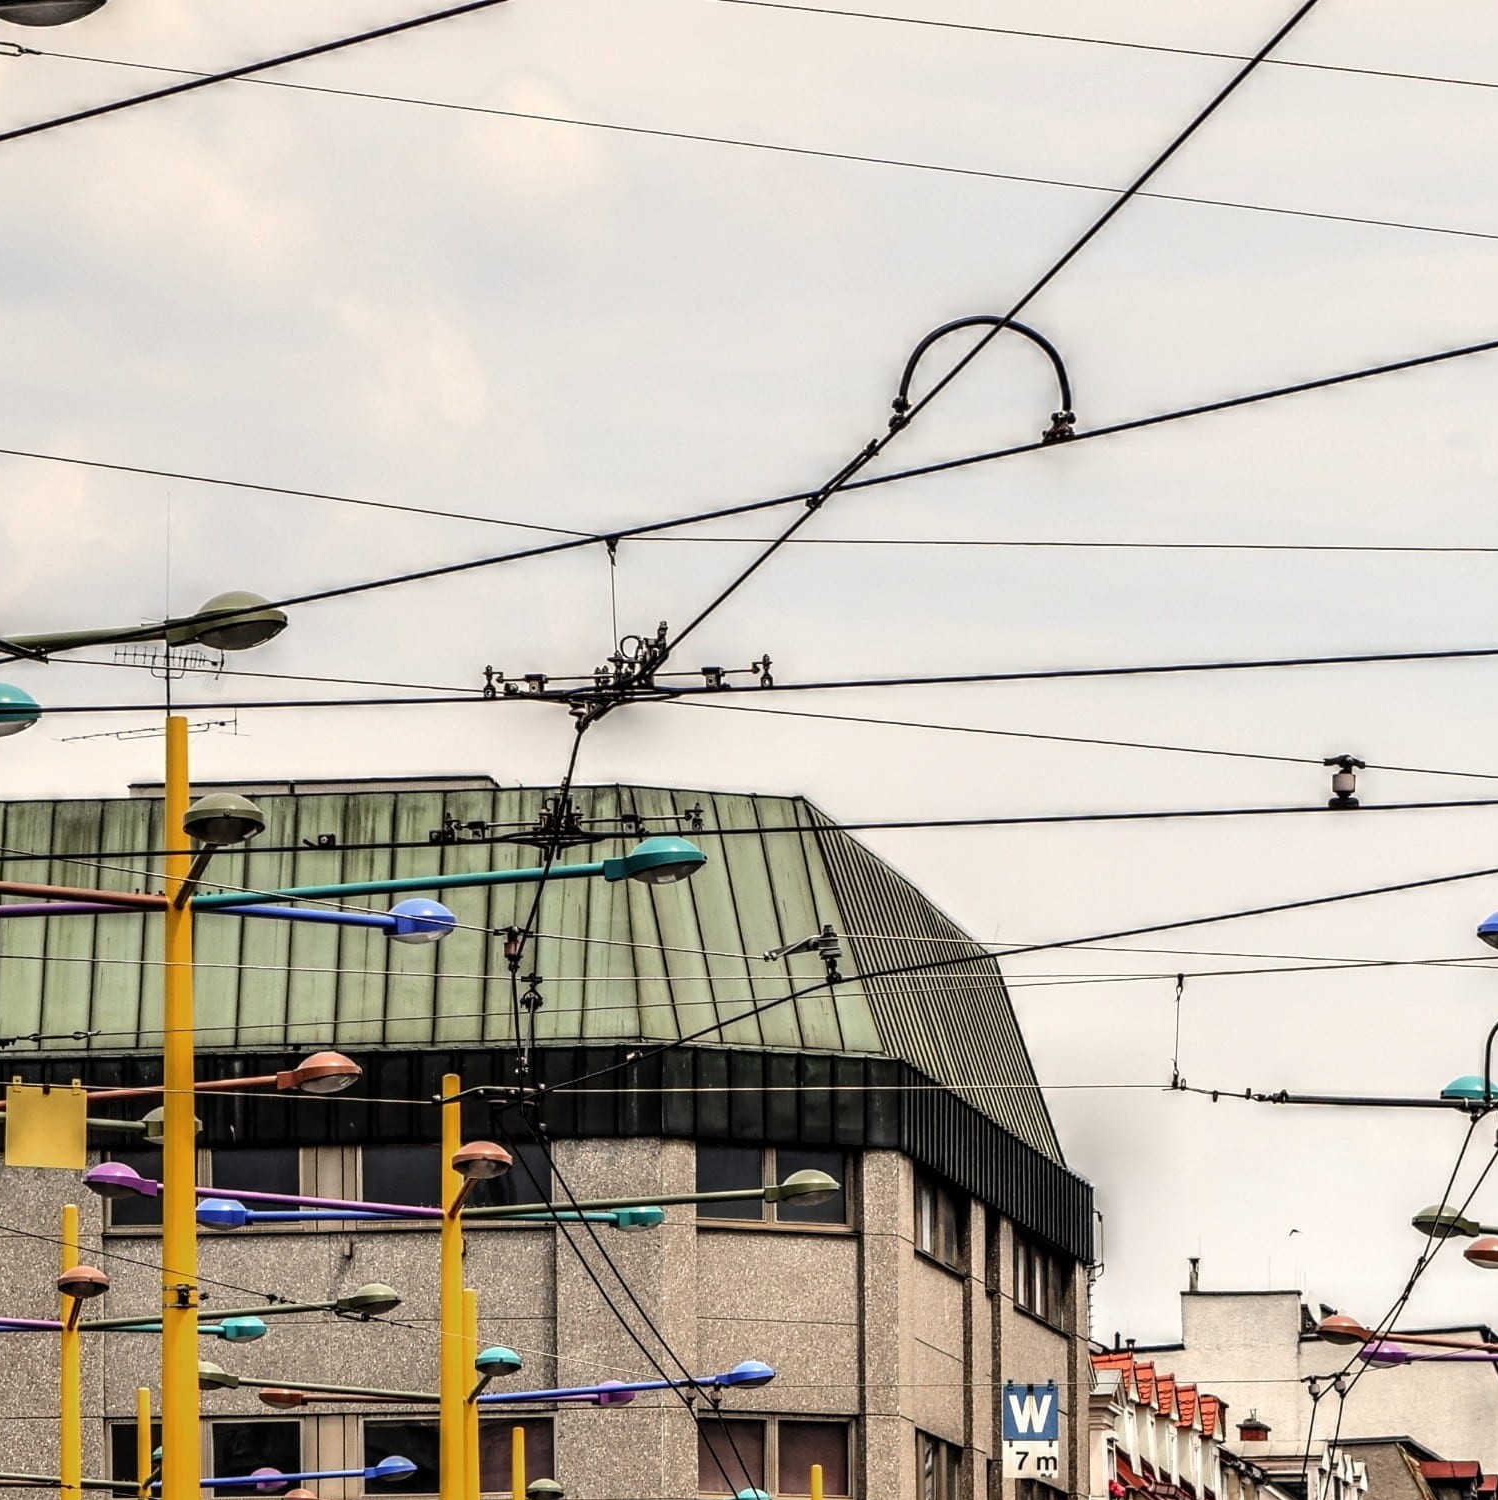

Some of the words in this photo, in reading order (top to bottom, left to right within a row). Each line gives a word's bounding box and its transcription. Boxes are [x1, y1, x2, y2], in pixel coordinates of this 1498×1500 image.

[1009, 1395, 1052, 1433] W
[1016, 1452, 1029, 1470] 7
[1037, 1456, 1057, 1470] m
